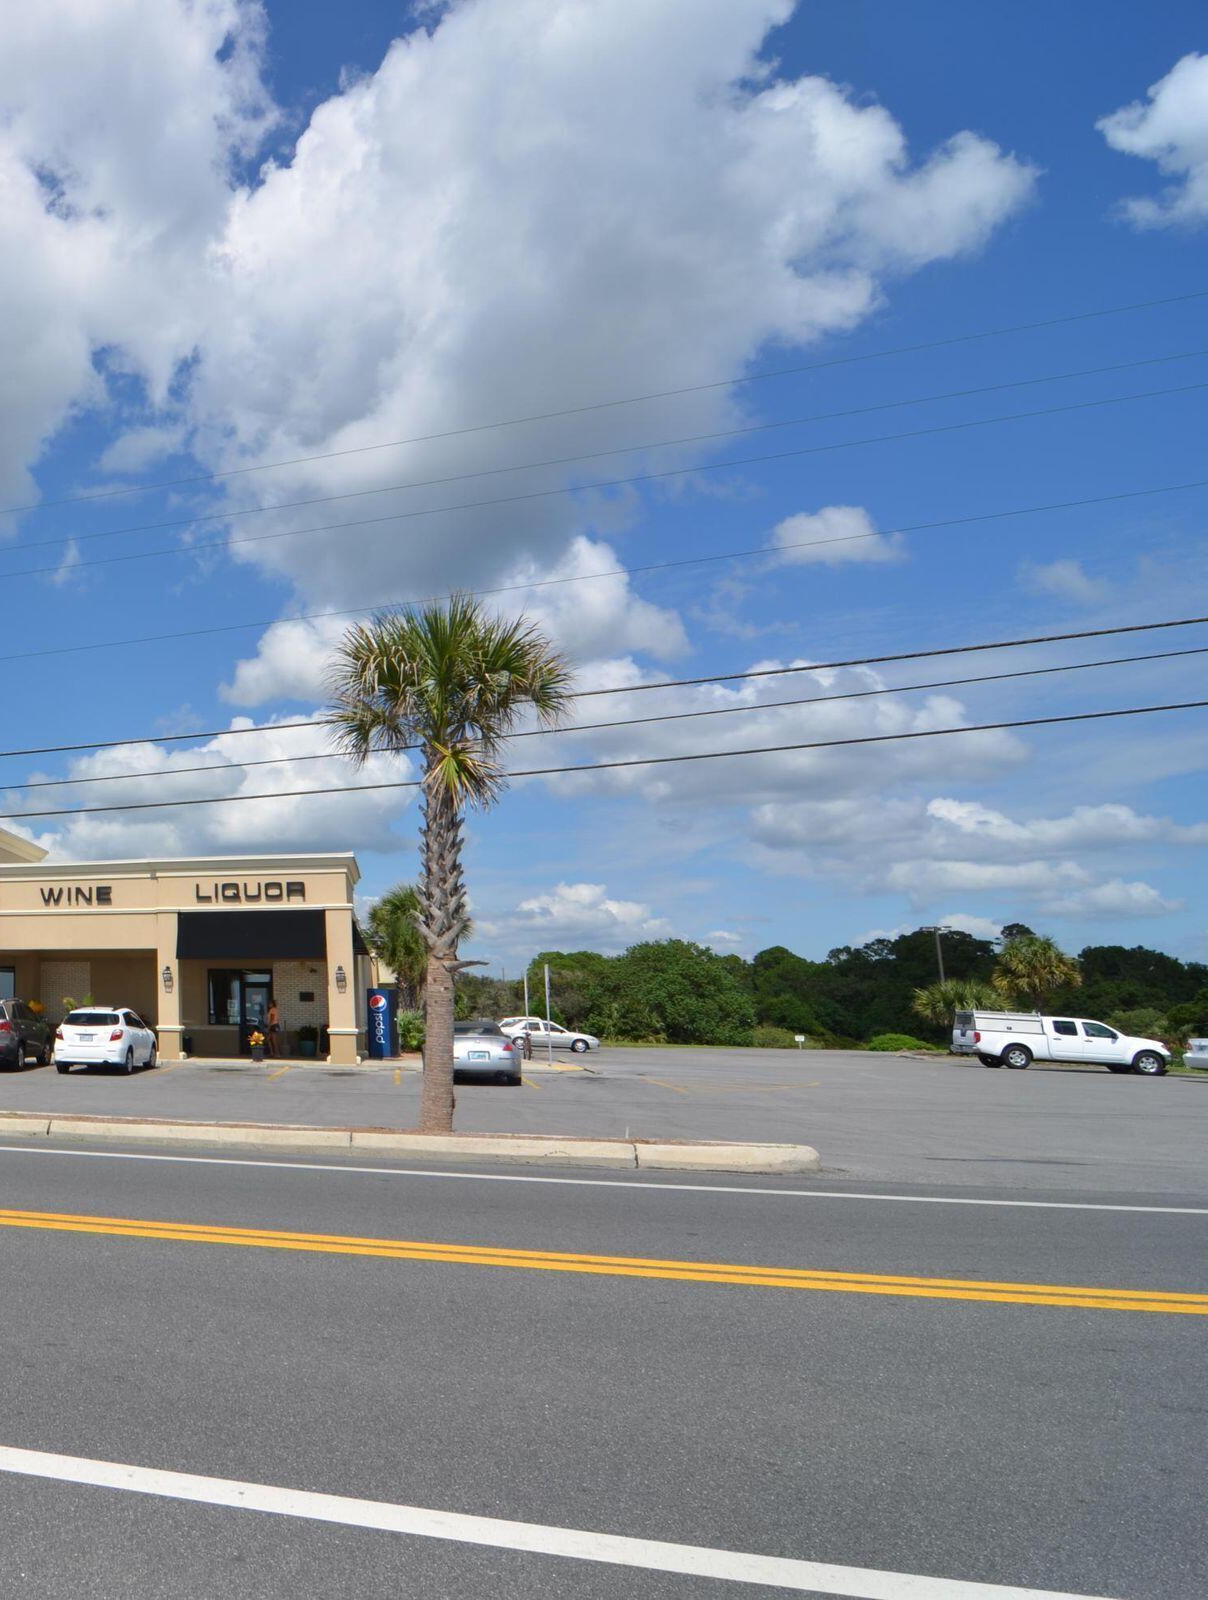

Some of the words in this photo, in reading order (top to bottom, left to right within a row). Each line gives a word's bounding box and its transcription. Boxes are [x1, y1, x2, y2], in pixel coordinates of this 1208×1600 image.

[40, 886, 113, 905] WINE
[195, 881, 306, 903] LIQUOR
[373, 1013, 386, 1043] pepsi
